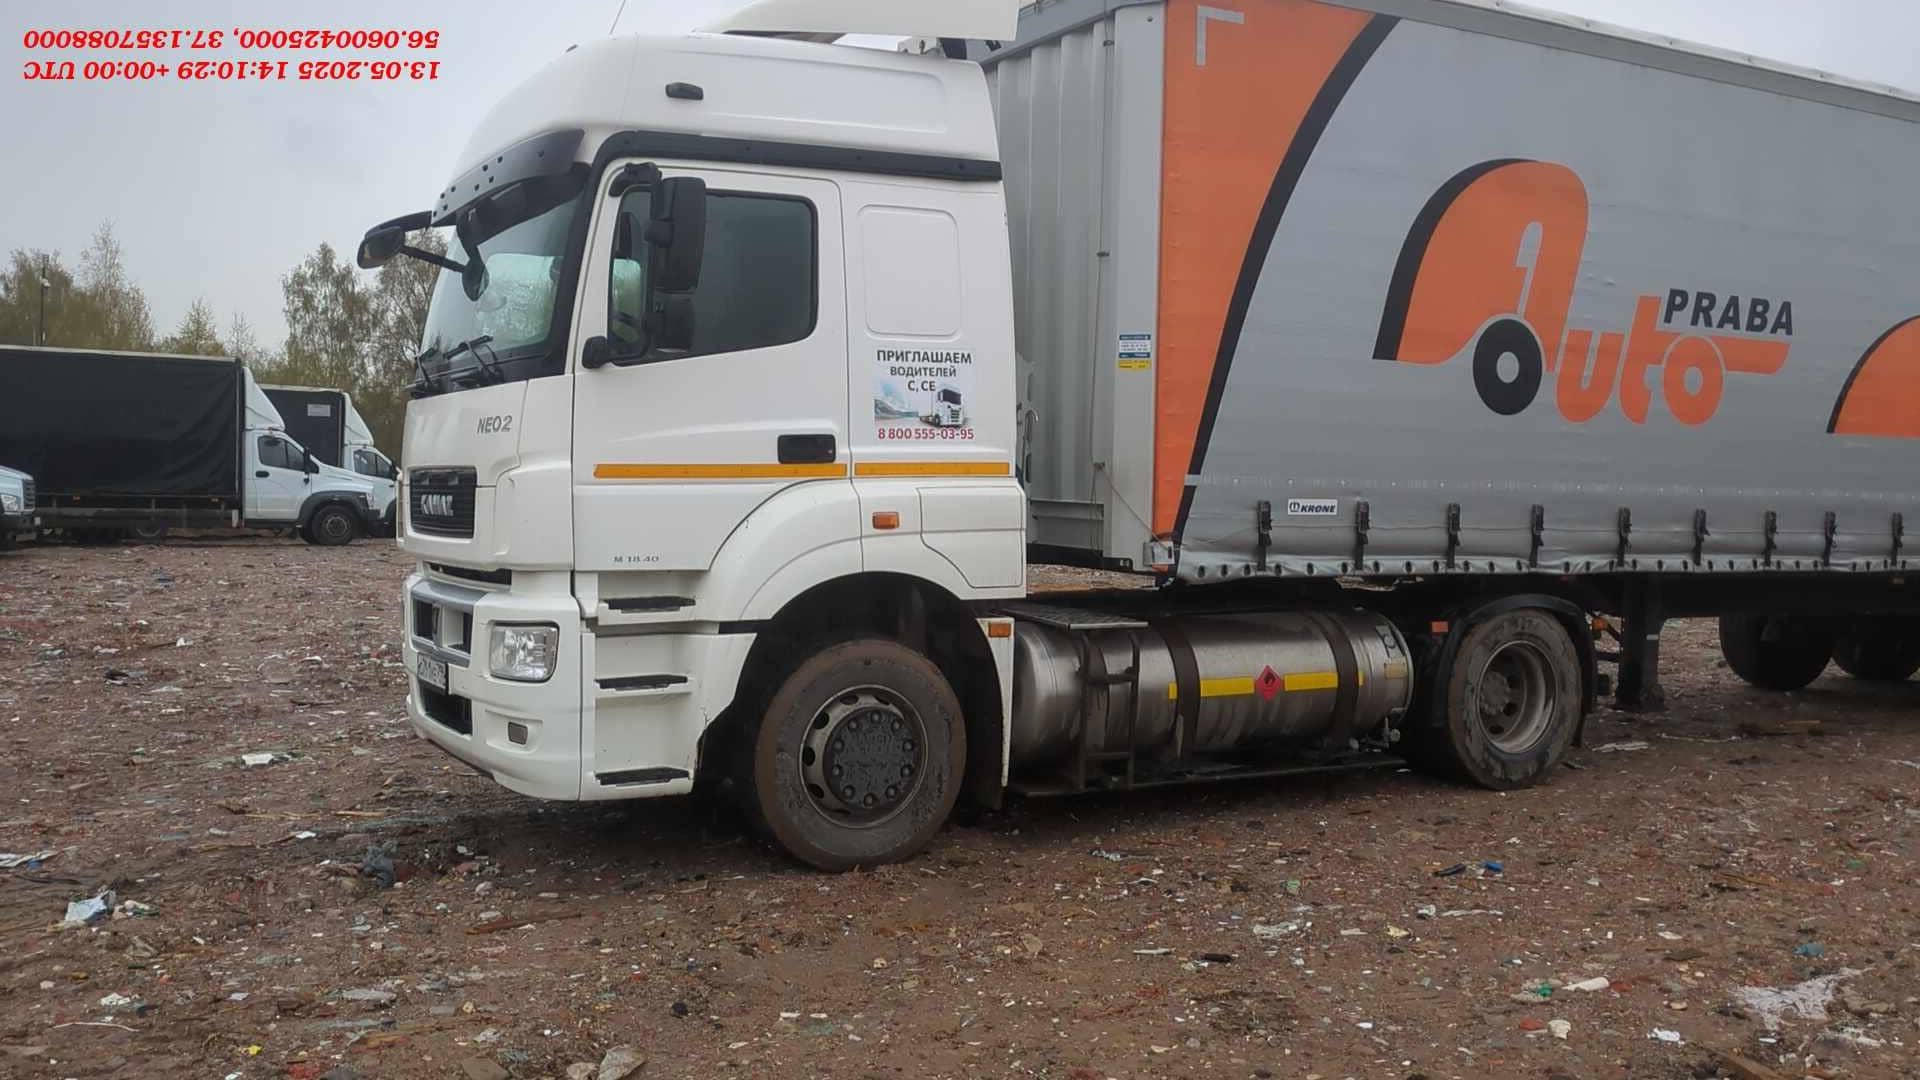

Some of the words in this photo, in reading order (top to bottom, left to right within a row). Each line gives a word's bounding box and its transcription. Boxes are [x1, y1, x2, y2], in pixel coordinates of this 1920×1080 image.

[1663, 288, 1793, 336] PRABA
[876, 350, 972, 364] ПРИГЛАШАЕМ
[890, 365, 957, 378] ВОДИТЕЛЕЙ
[878, 428, 886, 440] 8
[888, 428, 912, 440] 800
[914, 428, 974, 440] 555-03-95
[1300, 504, 1336, 513] KRONE
